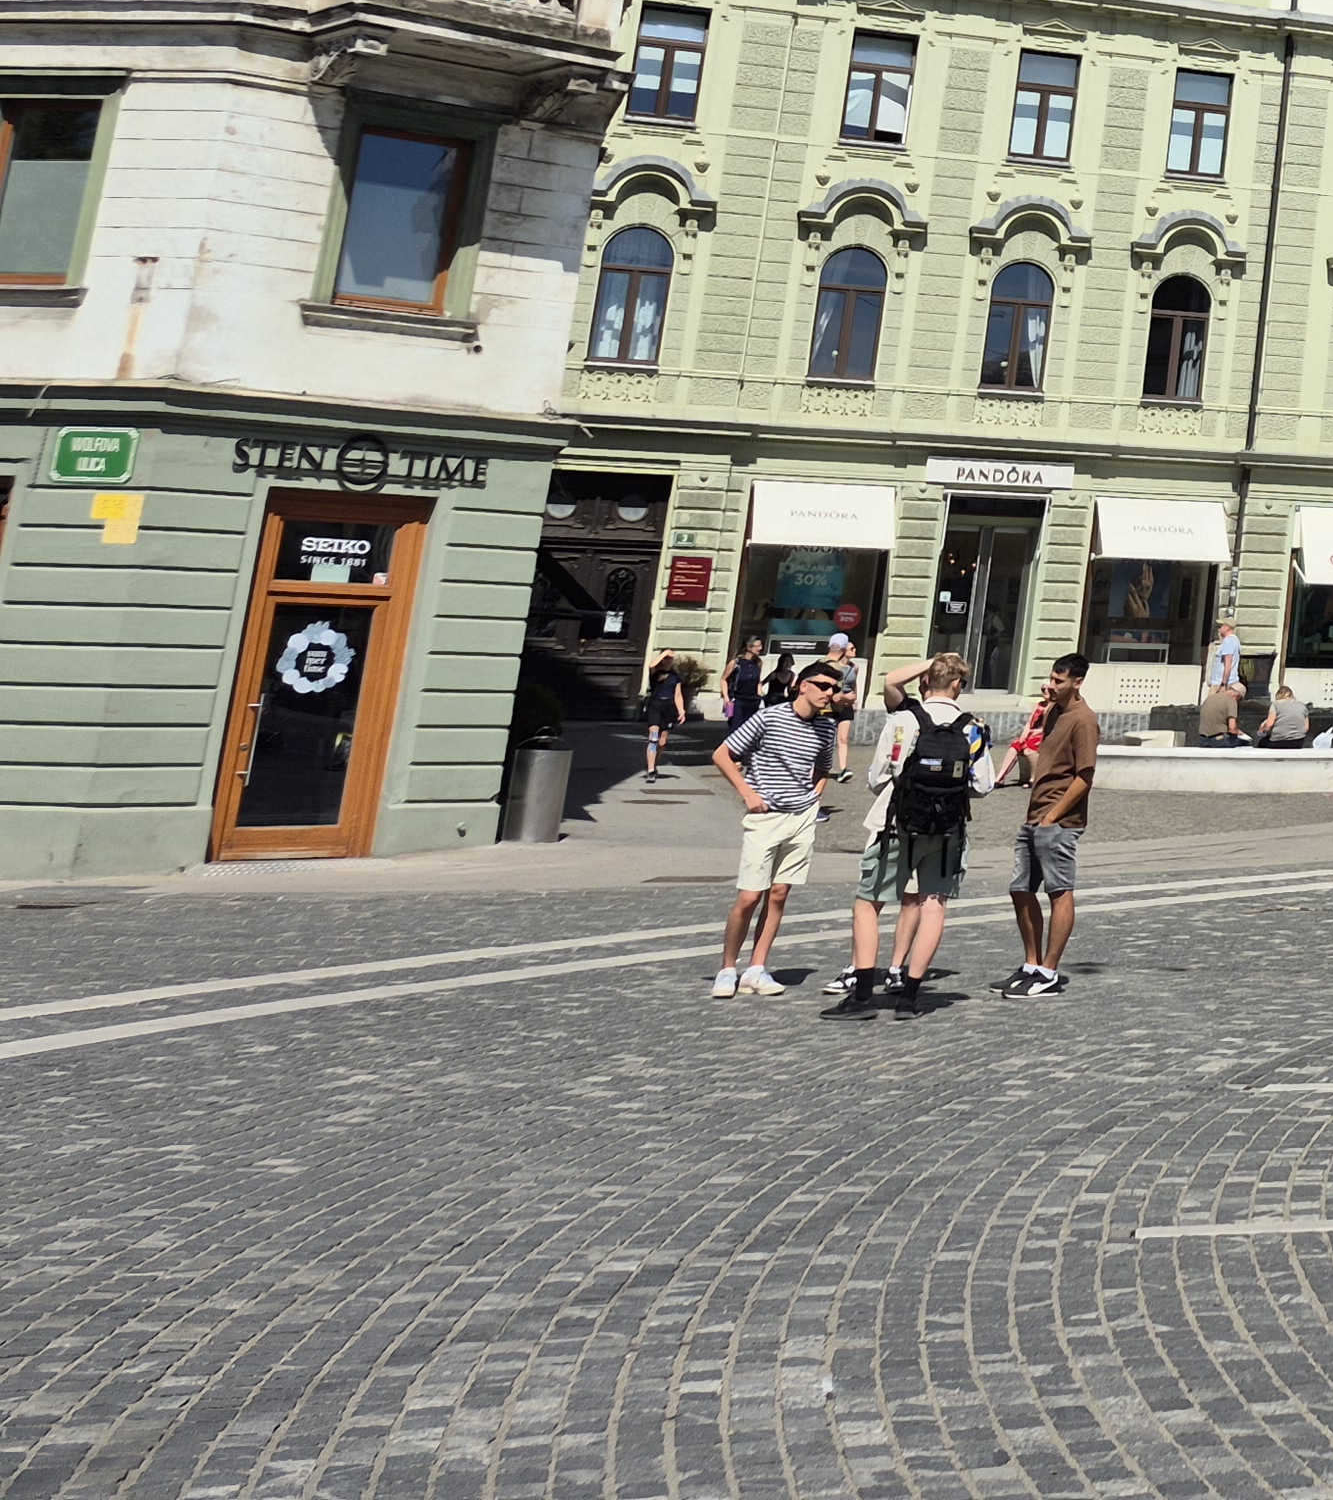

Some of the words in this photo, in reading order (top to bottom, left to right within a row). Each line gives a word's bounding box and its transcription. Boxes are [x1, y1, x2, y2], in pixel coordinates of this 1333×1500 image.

[71, 437, 120, 452] WOLFOVA
[76, 457, 106, 471] ULICA
[233, 438, 329, 474] STEN
[399, 450, 489, 483] TIME
[957, 466, 1043, 485] PANDORA
[791, 510, 858, 520] PANDORA
[1133, 524, 1195, 535] PANDORA
[301, 537, 372, 554] SEIKO
[300, 555, 337, 566] SINCE
[794, 573, 828, 586] 30%
